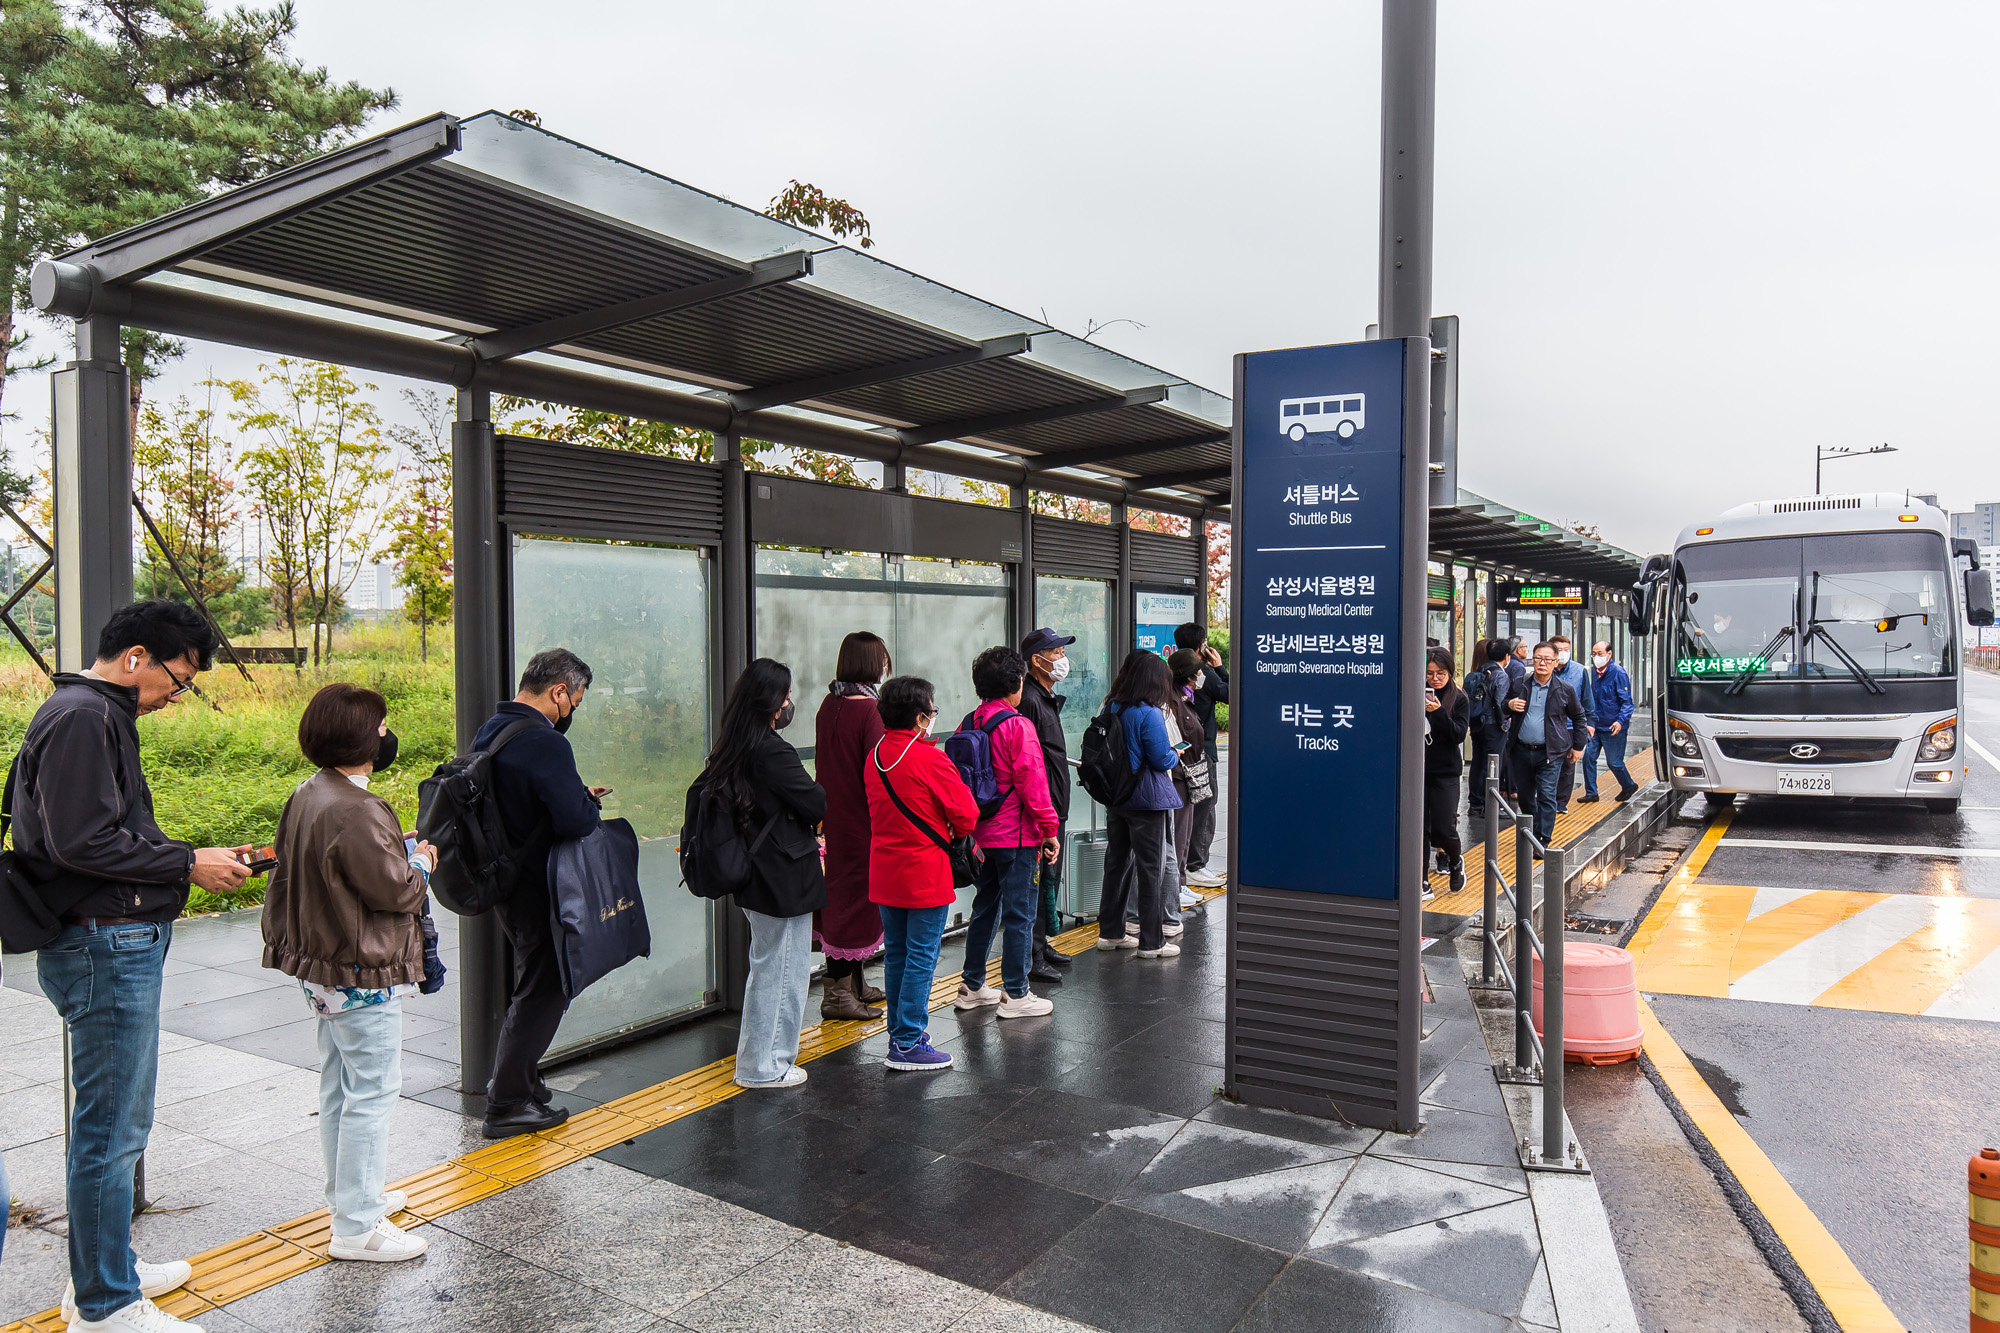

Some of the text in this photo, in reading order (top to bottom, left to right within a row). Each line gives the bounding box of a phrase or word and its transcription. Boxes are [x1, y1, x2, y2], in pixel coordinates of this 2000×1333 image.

[1283, 483, 1360, 505] 셔틀버스
[1289, 511, 1352, 526] Shuttle Bus
[1266, 575, 1375, 597] 삼성서울병원
[1266, 603, 1374, 619] Samsung Medical Center
[1256, 633, 1384, 655] 강남세브란스병원
[1256, 660, 1383, 678] Gangnam Severance Hospital
[1281, 704, 1355, 729] 타는 곳
[1296, 734, 1339, 751] Tracks
